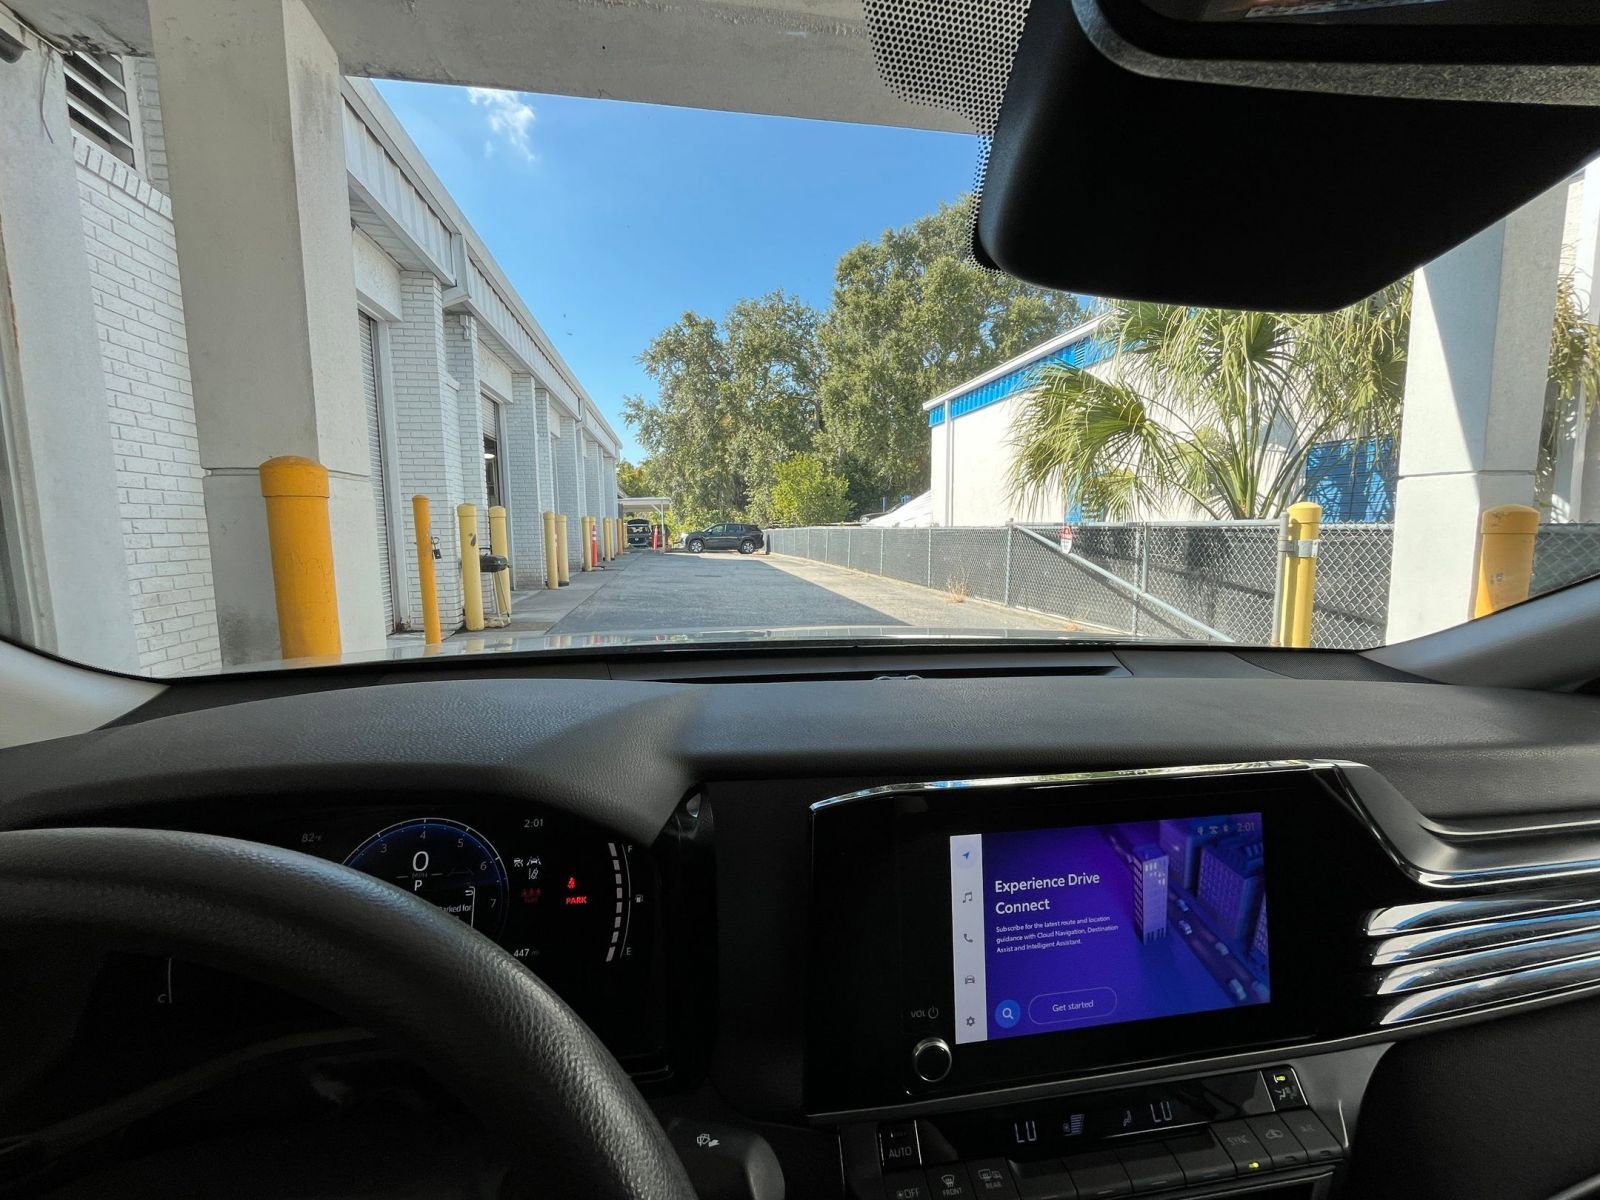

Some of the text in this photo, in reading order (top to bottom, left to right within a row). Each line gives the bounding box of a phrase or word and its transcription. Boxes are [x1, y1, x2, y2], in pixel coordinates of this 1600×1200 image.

[523, 818, 544, 828] 2:01
[1237, 822, 1255, 832] 2:01
[419, 830, 426, 840] 4
[380, 843, 388, 853] 3
[457, 838, 464, 848] 5
[627, 845, 633, 853] F
[480, 861, 487, 871] 6
[414, 879, 423, 891] P
[995, 872, 1100, 894] Experience Drive
[490, 898, 497, 909] 7
[565, 895, 588, 905] PARK
[995, 898, 1051, 914] Connect
[996, 924, 1024, 933] Subscribe
[1025, 923, 1033, 931] for
[1089, 915, 1110, 923] location
[996, 934, 1023, 944] guidance
[1024, 932, 1036, 940] with
[1037, 931, 1055, 939] Cloud
[1087, 924, 1119, 934] Destination
[626, 947, 632, 956] E
[996, 944, 1014, 953] Assist
[1014, 944, 1025, 952] and
[1026, 941, 1055, 950] Intelligent
[513, 948, 530, 957] 447
[1052, 999, 1094, 1012] Get started
[910, 1009, 926, 1018] VOL
[888, 1146, 912, 1159] AUTO
[904, 1186, 920, 1199] OFF
[942, 1186, 962, 1197] FRONT
